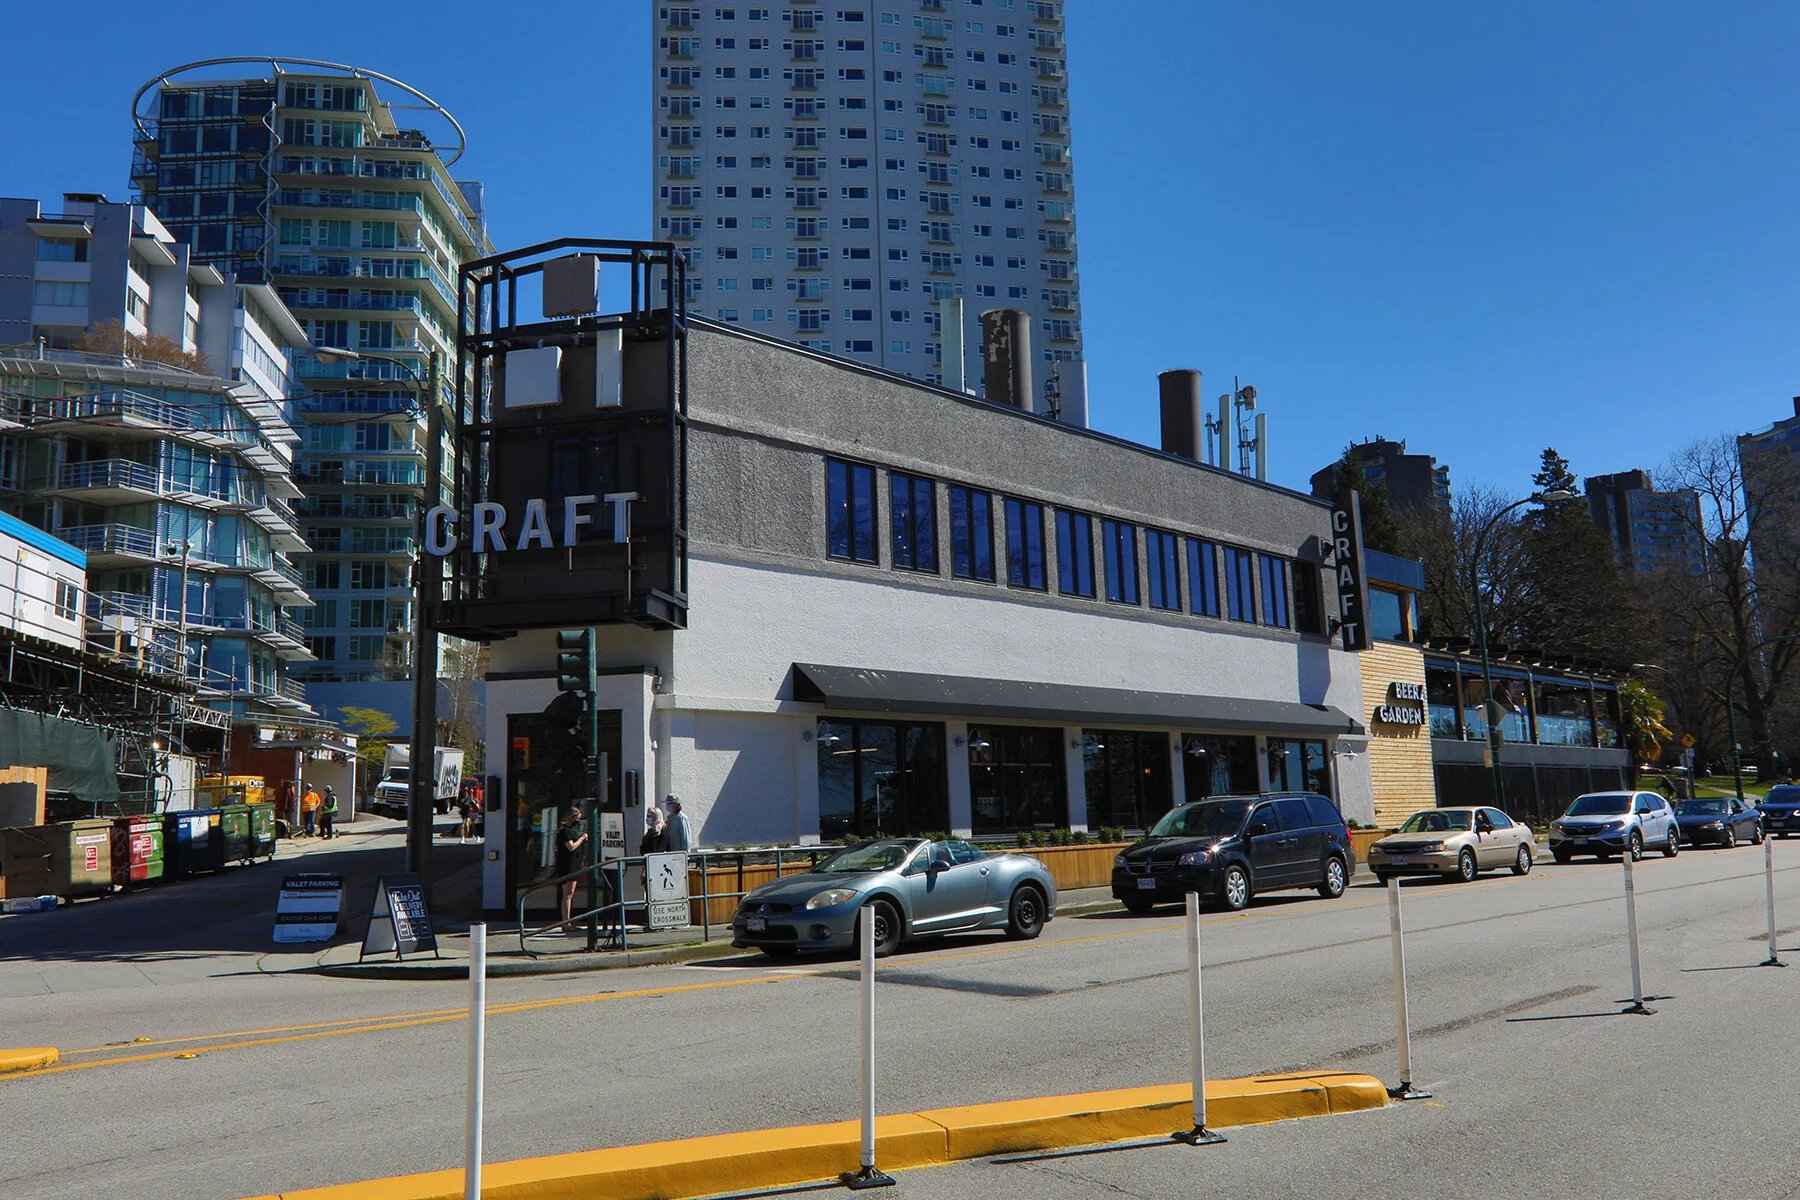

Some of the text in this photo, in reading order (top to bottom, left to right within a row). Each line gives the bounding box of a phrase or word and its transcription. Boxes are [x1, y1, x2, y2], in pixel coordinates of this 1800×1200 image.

[425, 491, 640, 557] CRAFT
[1333, 510, 1358, 645] CRAFT
[1395, 682, 1420, 700] BEER
[1380, 705, 1422, 725] GARDEN
[605, 831, 620, 839] VALET
[602, 839, 624, 848] PARKING
[396, 909, 425, 920] AVAILABLE
[653, 905, 686, 915] USE NORTH
[653, 915, 687, 924] CROSSWALK
